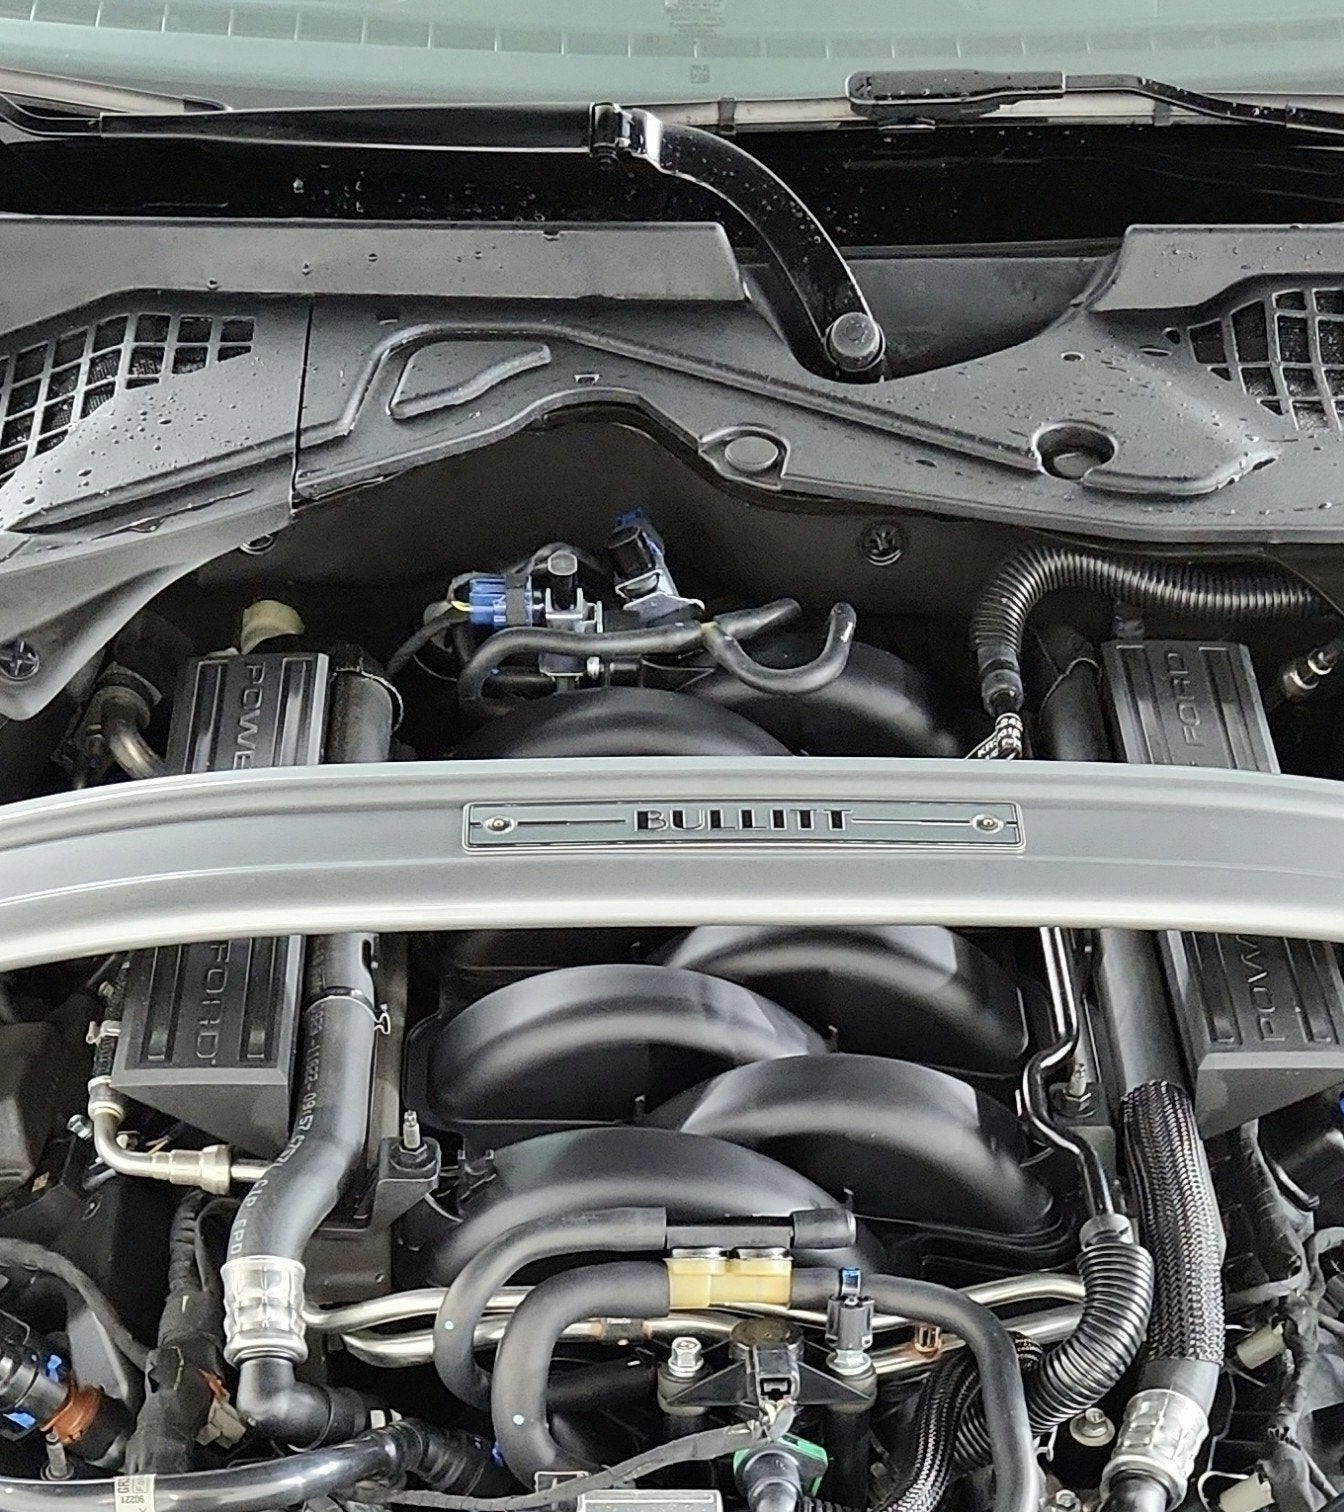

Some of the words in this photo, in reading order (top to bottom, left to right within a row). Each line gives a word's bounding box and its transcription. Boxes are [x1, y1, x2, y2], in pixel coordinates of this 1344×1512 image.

[233, 663, 267, 768] POWE
[1166, 652, 1205, 747] FORD
[634, 808, 853, 831] BULLITT
[195, 942, 231, 1060] FORD
[231, 1218, 247, 1255] EPD
